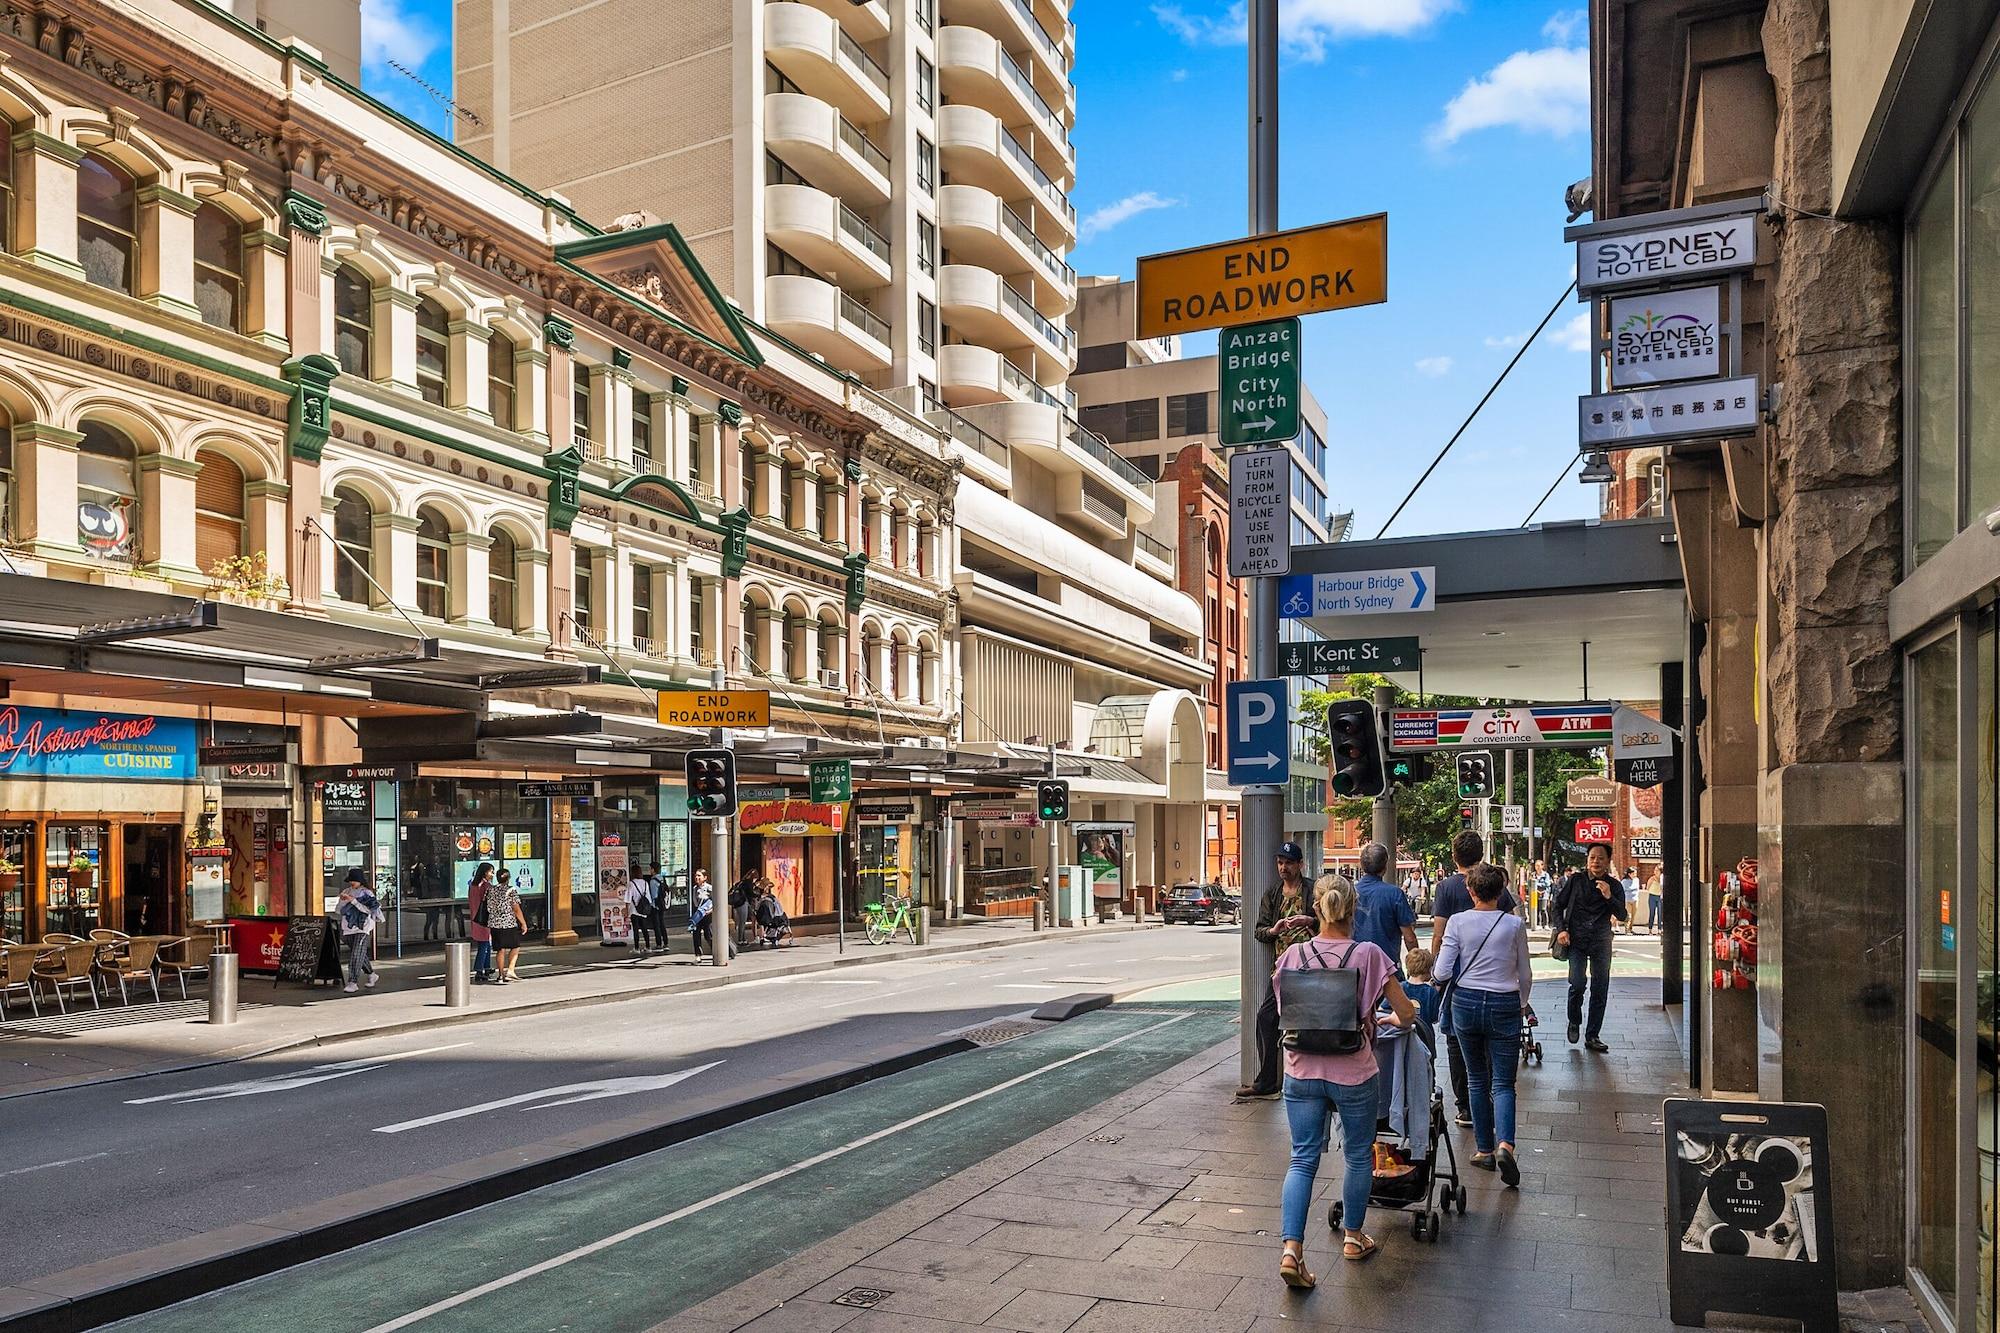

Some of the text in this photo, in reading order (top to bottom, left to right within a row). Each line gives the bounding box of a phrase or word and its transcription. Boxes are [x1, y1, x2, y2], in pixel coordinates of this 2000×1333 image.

[1597, 228, 1736, 264] SYDNEY
[1224, 248, 1290, 281] END
[1597, 247, 1737, 278] HOTEL CBD
[1164, 269, 1355, 322] ROADWORK
[1230, 330, 1290, 348] Anzac
[1617, 323, 1713, 347] SYDNEY
[1617, 336, 1714, 357] HOTEL CBD
[1229, 350, 1290, 370] Bridge
[1238, 376, 1280, 394] City
[1232, 394, 1287, 413] North
[1246, 457, 1272, 468] LEFT
[1245, 469, 1274, 481] TURN
[1245, 482, 1275, 494] FROM
[1237, 494, 1281, 507] BICYCLE
[1245, 508, 1274, 519] LANE
[1249, 521, 1270, 532] USE
[1245, 534, 1274, 545] TURN
[1249, 547, 1270, 558] BOX
[1241, 559, 1278, 571] AHEAD
[1318, 576, 1405, 593] Harbour Bridge
[1318, 595, 1394, 611] North Sydney
[1314, 642, 1380, 661] Kent St
[697, 696, 729, 707] END
[669, 710, 758, 722] ROADWORK
[1239, 692, 1276, 742] P
[1561, 718, 1592, 730] ATM
[16, 717, 156, 758] Asturiana
[1473, 735, 1532, 744] convenience
[1621, 732, 1659, 745] Cash2Go
[100, 743, 177, 754] NORTHERN SPANISH
[103, 754, 173, 769] CUISINE
[1631, 760, 1656, 771] ATM
[814, 765, 846, 774] Anzac
[815, 774, 847, 785] Bridge
[1630, 771, 1658, 782] HERE
[1571, 786, 1614, 796] SANCTUARY
[1579, 824, 1610, 841] PARTY
[601, 837, 621, 846] OPEN
[1639, 846, 1661, 855] EVEN
